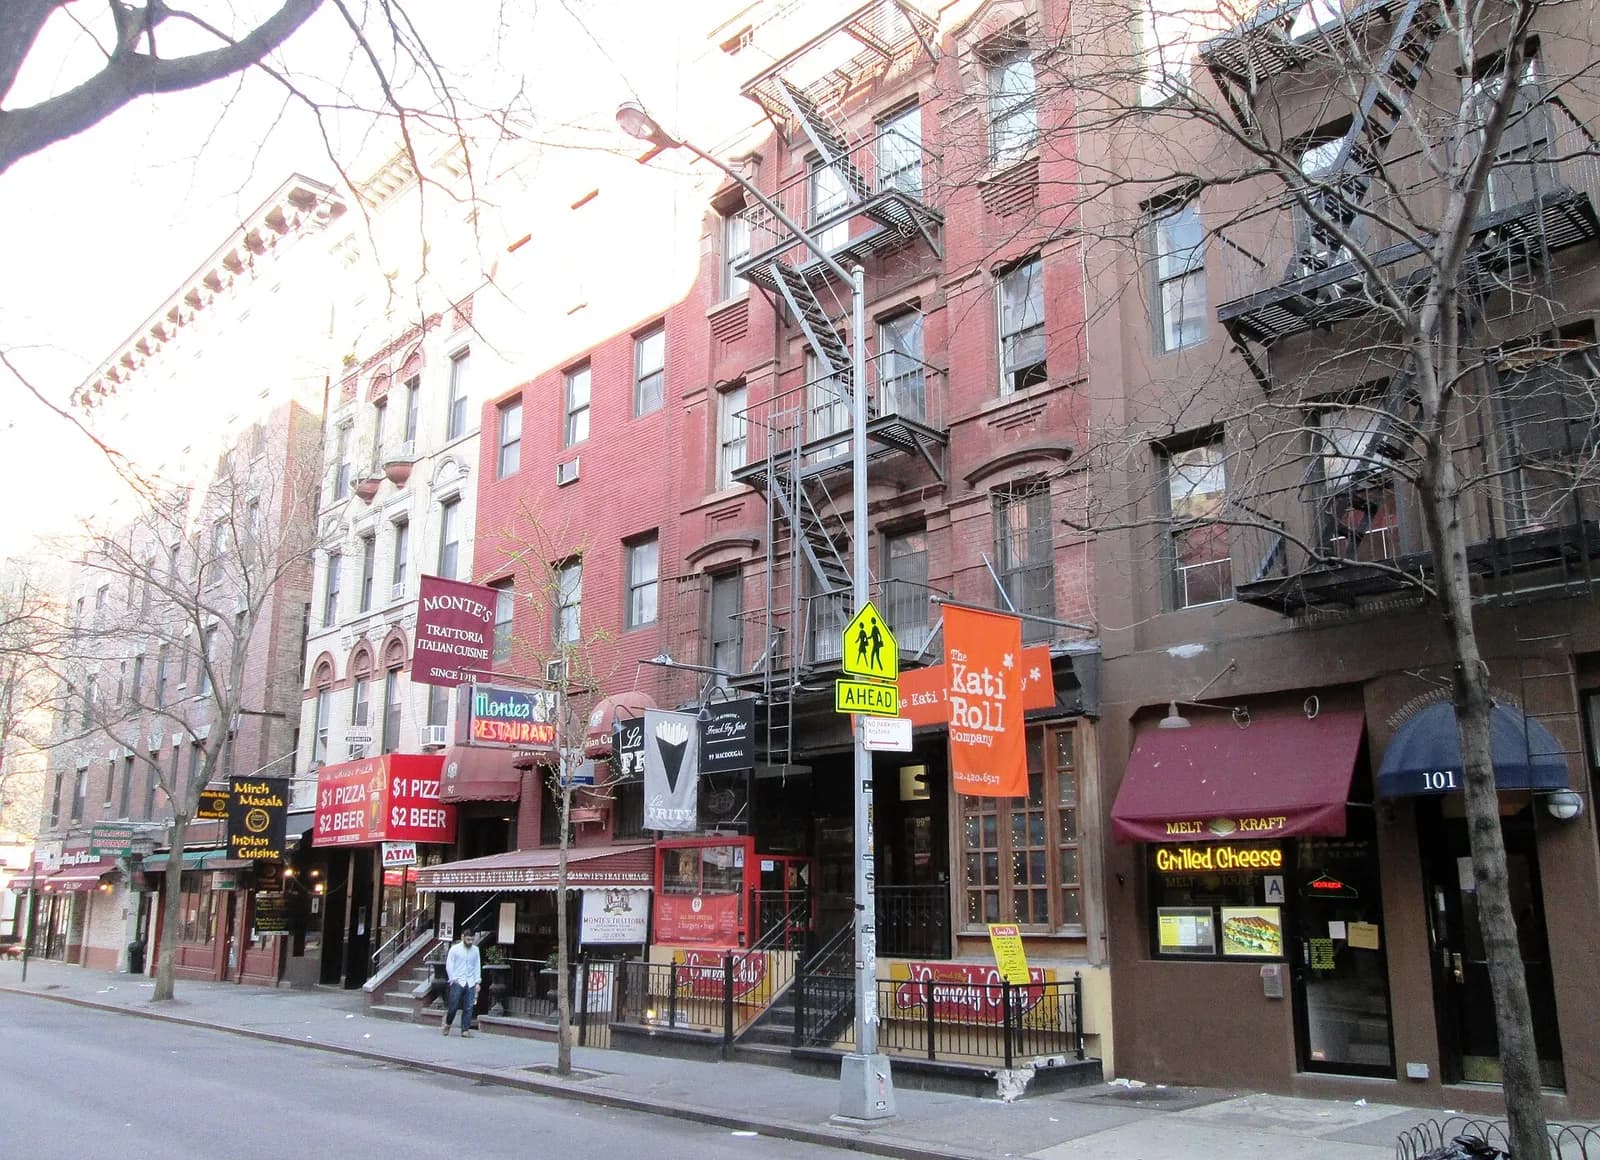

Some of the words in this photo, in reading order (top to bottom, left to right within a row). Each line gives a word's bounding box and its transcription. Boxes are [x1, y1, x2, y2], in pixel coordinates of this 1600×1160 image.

[423, 595, 493, 623] MONTE'S
[426, 624, 484, 644] TRATTORIA
[417, 638, 453, 654] ITALIAN
[454, 645, 488, 660] CUISINE
[951, 648, 967, 662] The
[430, 667, 457, 680] SINCE
[951, 663, 1006, 700] Kati
[846, 687, 892, 708] AHEAD
[911, 690, 938, 706] Kati
[949, 696, 1006, 732] Roll
[474, 719, 554, 743] RESTAURANT
[622, 726, 642, 749] La
[950, 728, 993, 747] Company
[234, 782, 269, 795] Mirch
[393, 777, 407, 799] $1
[1423, 770, 1457, 790] 101
[239, 795, 283, 807] Masala
[321, 788, 333, 809] $1
[335, 784, 366, 805] PIZZA
[320, 814, 332, 835] $2
[334, 810, 365, 831] BEER
[391, 806, 407, 829] $2
[410, 808, 447, 829] BEER
[1166, 821, 1202, 835] MELT
[1239, 816, 1287, 832] KRAFT
[231, 834, 269, 846] Indian
[238, 847, 280, 859] Cuisine
[385, 849, 415, 861] ATM
[736, 849, 743, 862] A
[1157, 847, 1213, 870] Grilled
[1216, 846, 1281, 869] Cheese
[1269, 879, 1282, 896] A
[920, 967, 981, 1012] Comedy
